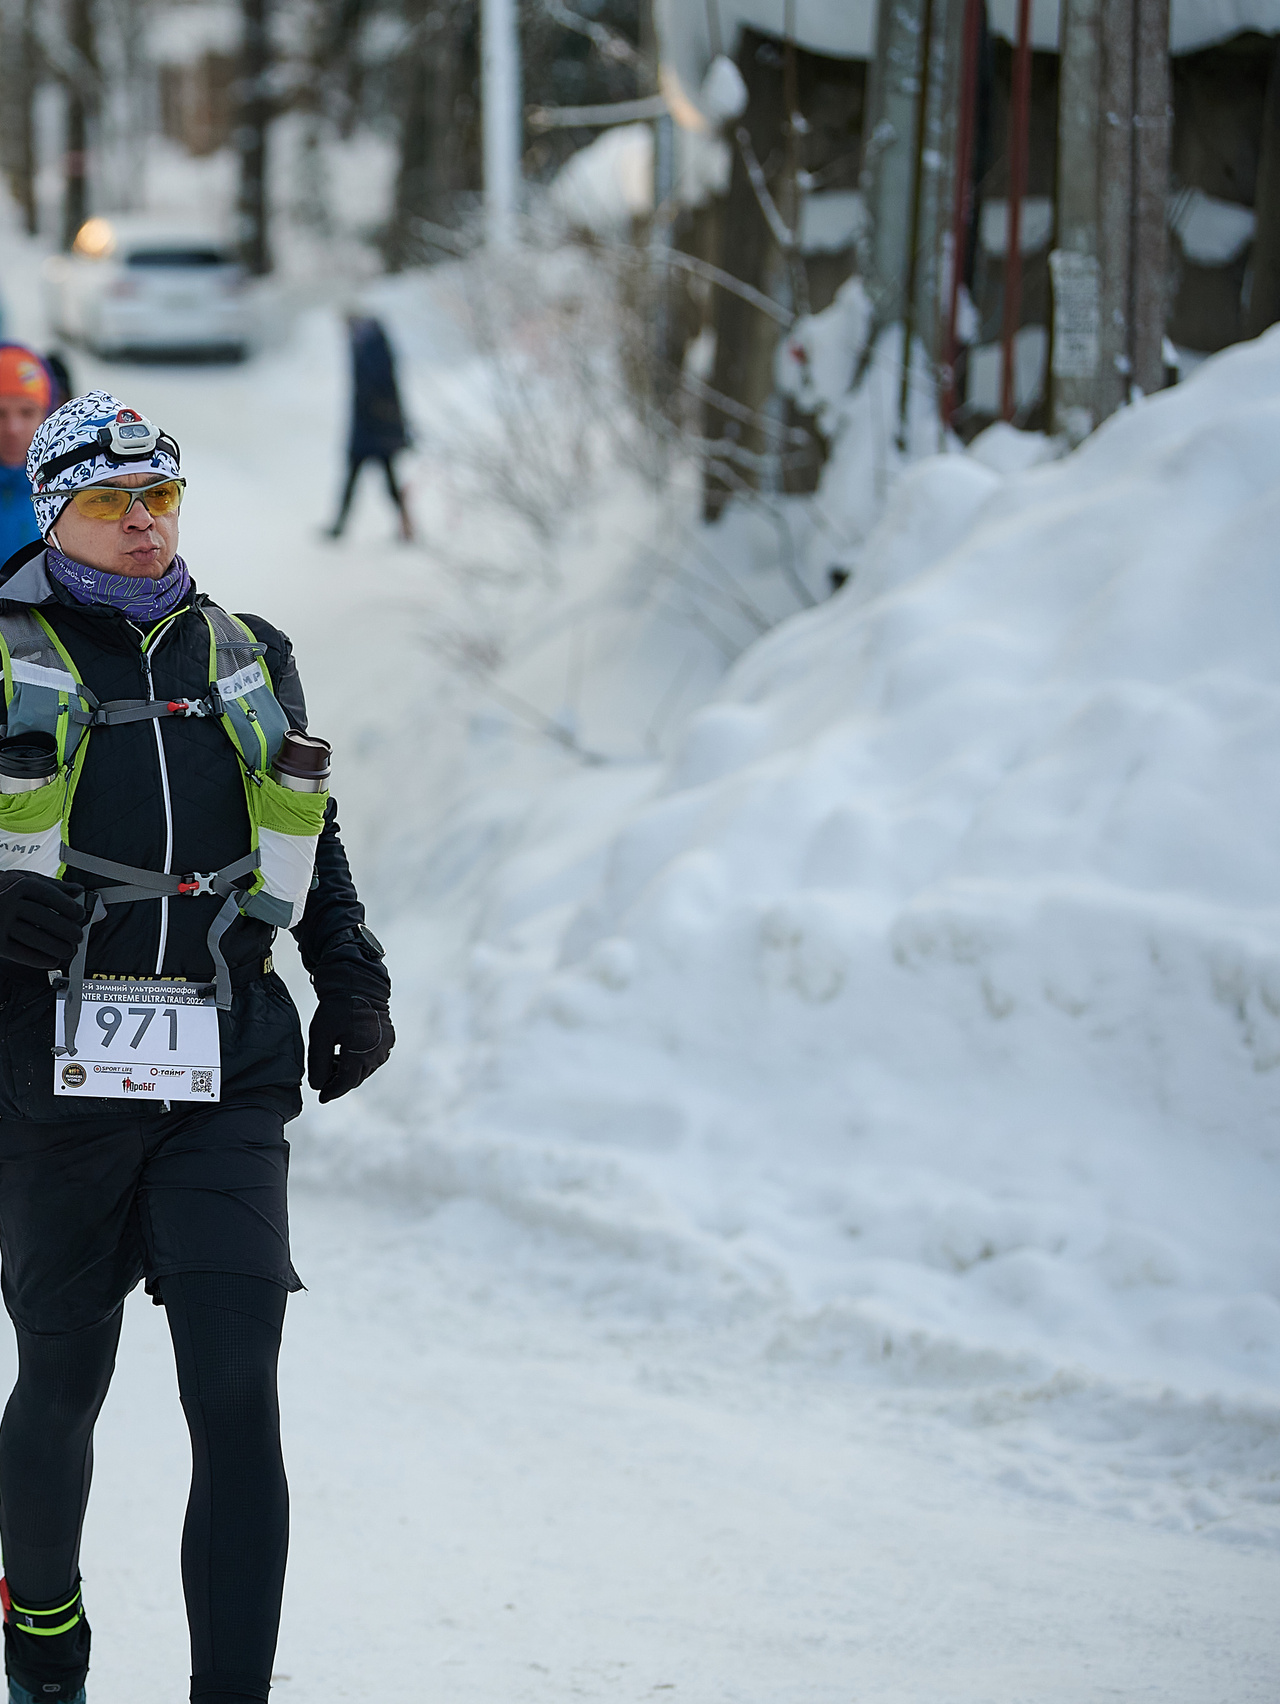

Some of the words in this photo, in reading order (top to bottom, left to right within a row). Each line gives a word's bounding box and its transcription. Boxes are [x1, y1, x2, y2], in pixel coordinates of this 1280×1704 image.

[223, 671, 261, 696] CAMP
[95, 984, 127, 992] зимний
[129, 986, 197, 995] ультрамарафон
[103, 993, 140, 1002] EXTREME
[96, 1006, 178, 1051] 971
